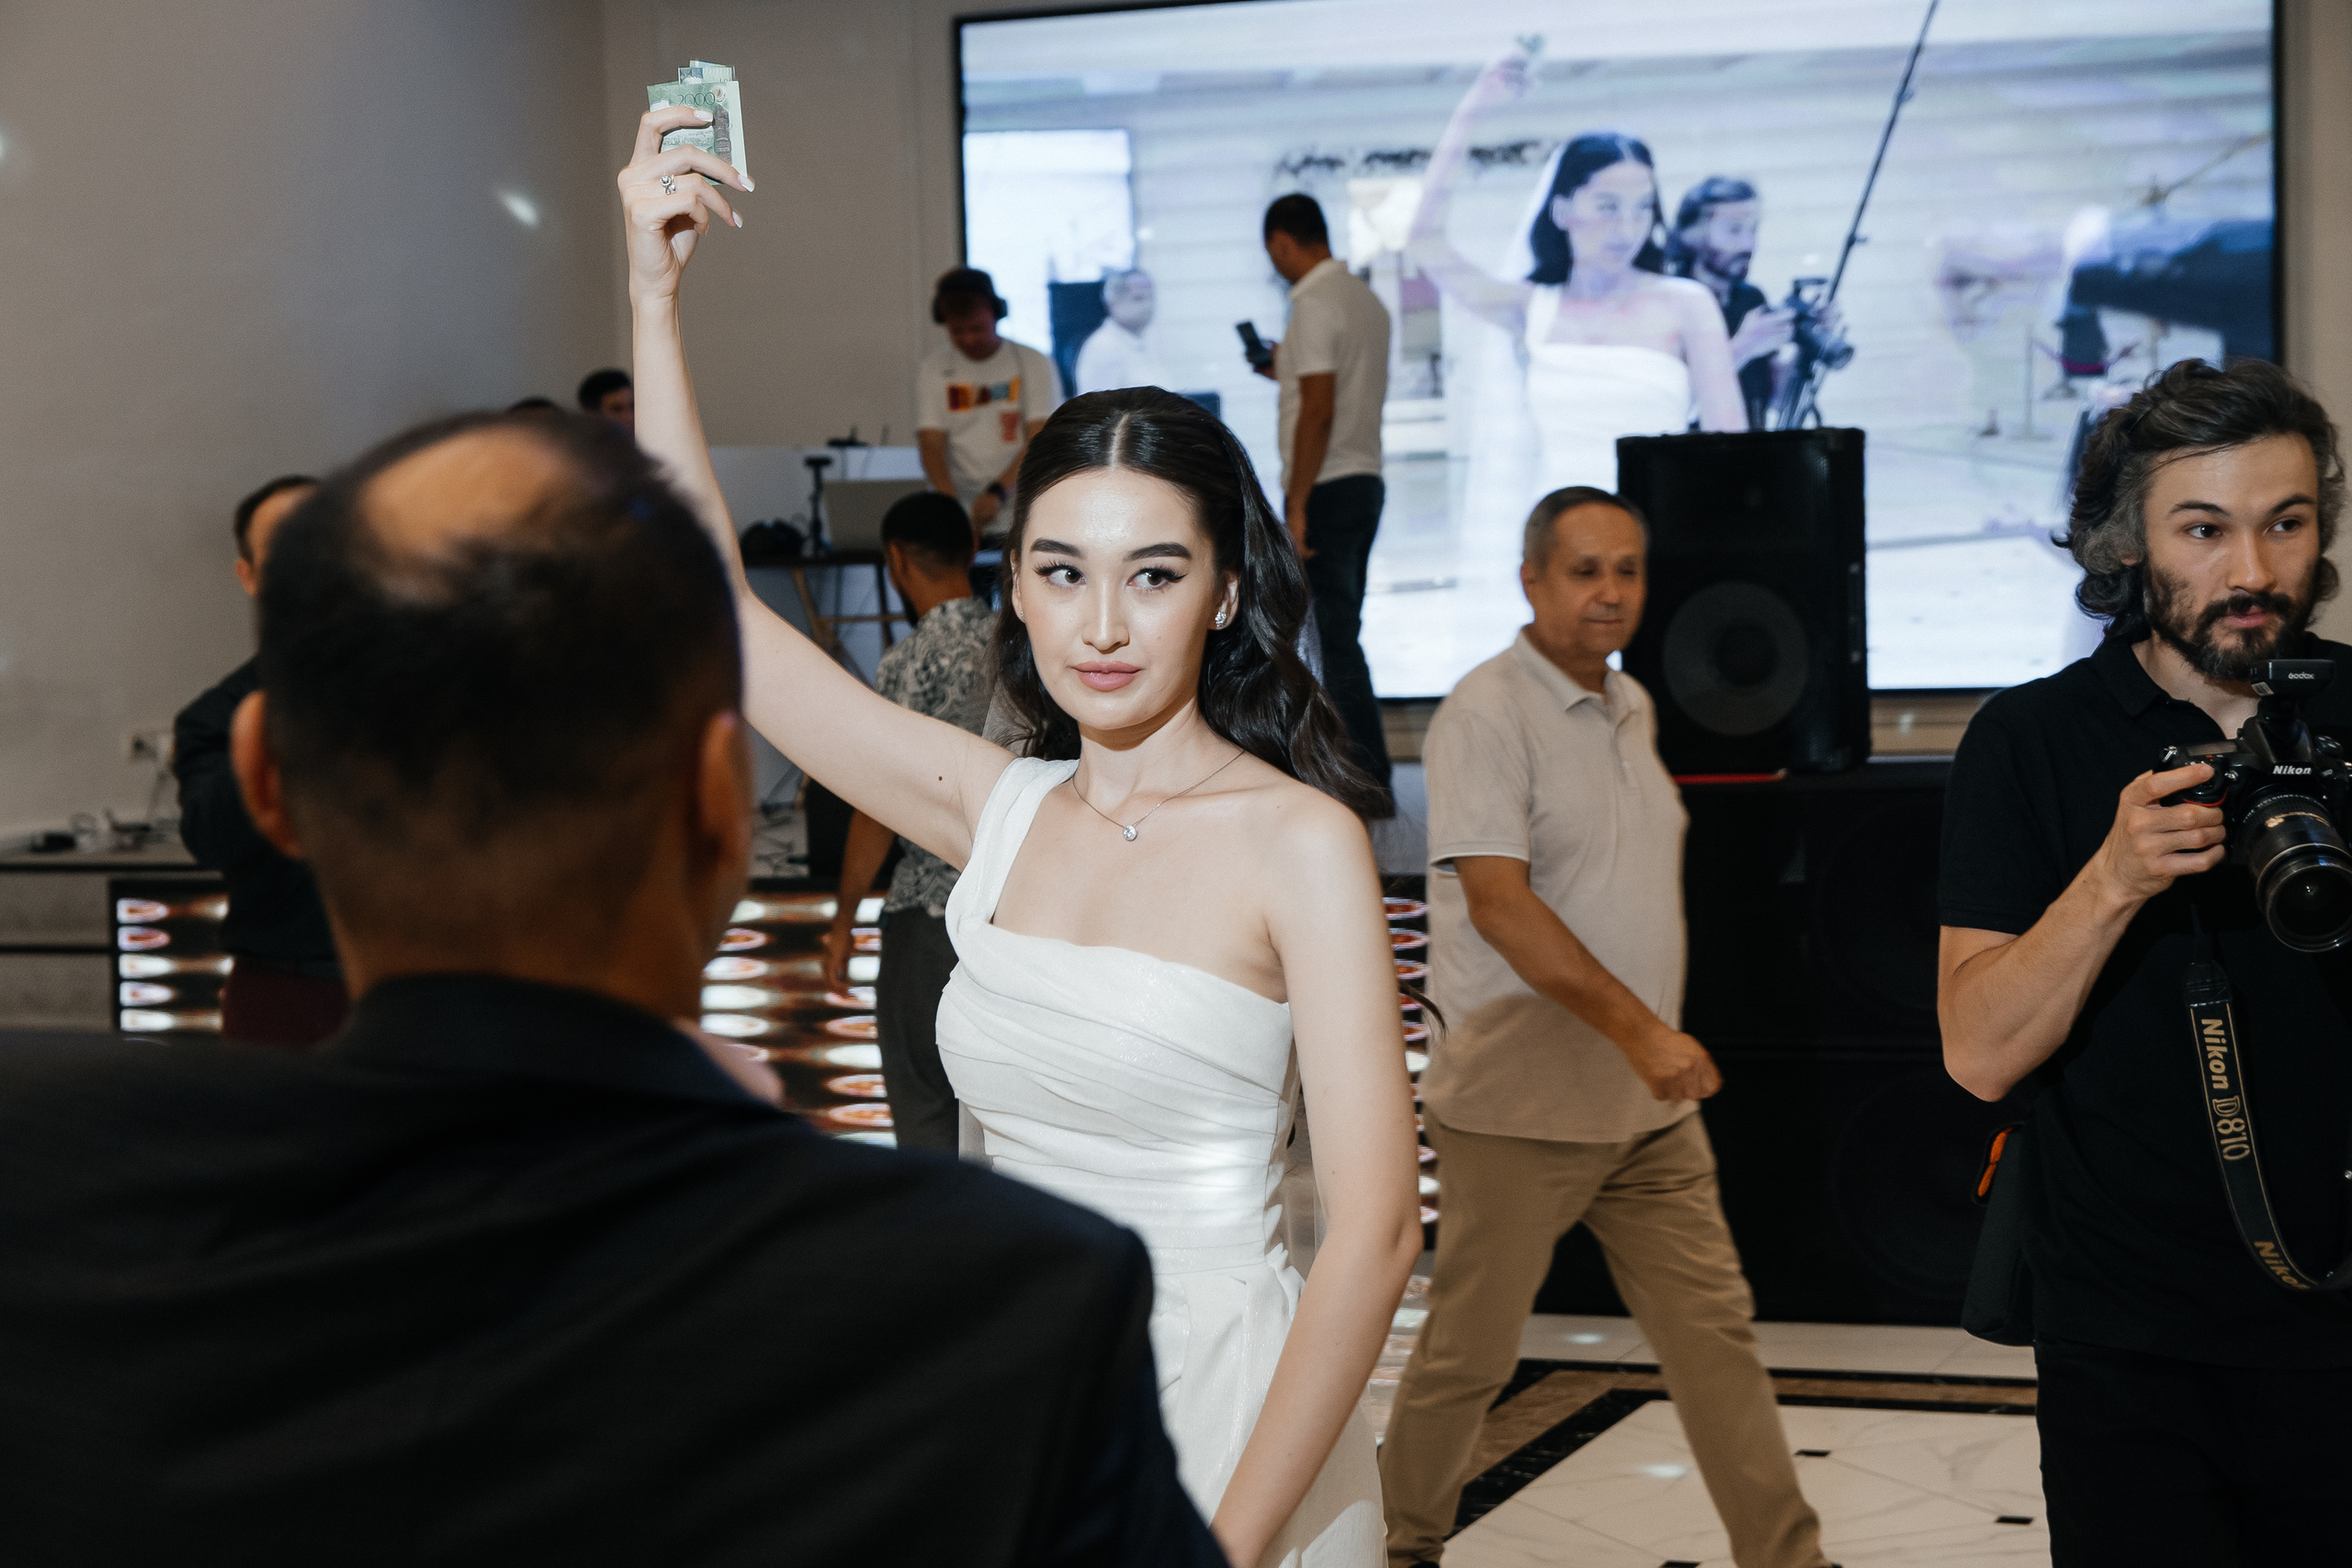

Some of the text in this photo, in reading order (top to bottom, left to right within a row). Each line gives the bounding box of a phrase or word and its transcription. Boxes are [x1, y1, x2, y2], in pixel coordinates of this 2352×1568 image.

[2273, 765, 2312, 774] Nikon
[2201, 1019, 2250, 1161] Nikon D810
